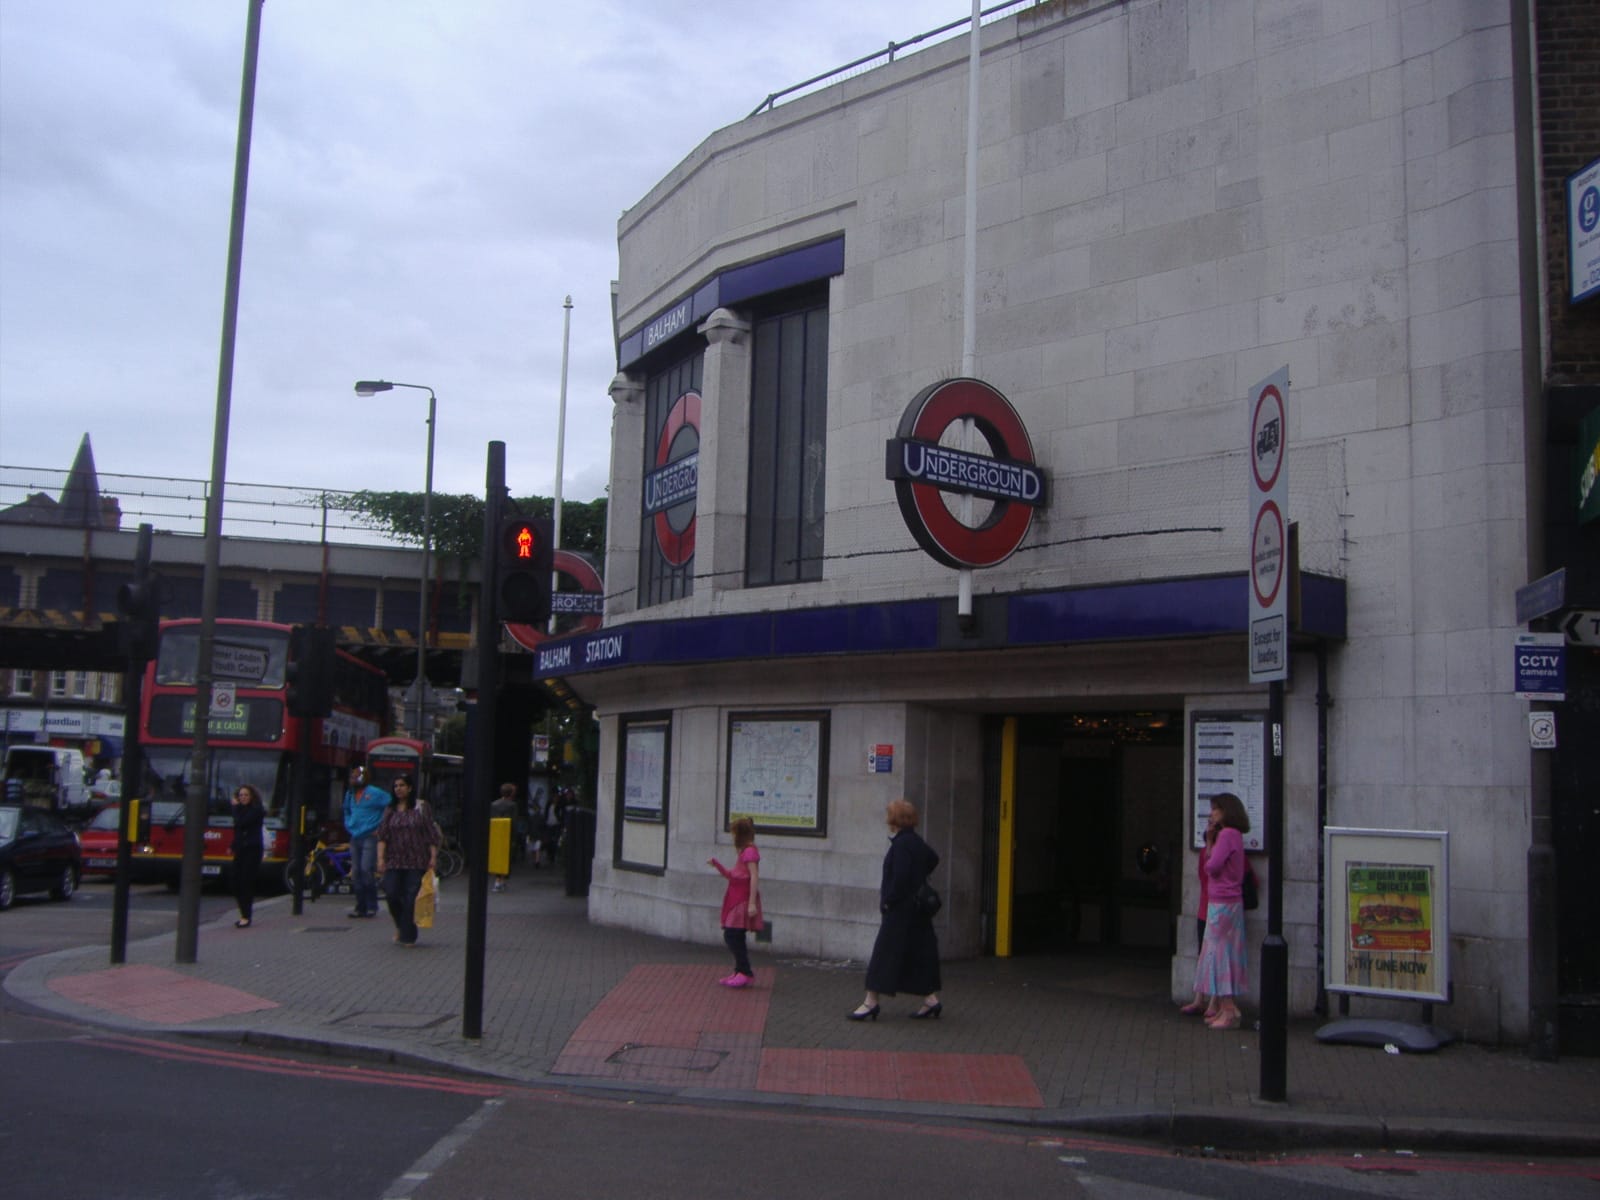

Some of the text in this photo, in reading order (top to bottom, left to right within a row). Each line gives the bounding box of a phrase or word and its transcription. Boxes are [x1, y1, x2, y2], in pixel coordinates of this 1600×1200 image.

[648, 306, 686, 346] BALHAM
[904, 442, 1040, 501] UNDERGROUND
[540, 635, 623, 671] BALHAM STATION
[1519, 655, 1560, 668] CCTV
[1520, 669, 1558, 678] cameras
[1400, 961, 1427, 975] NOW
